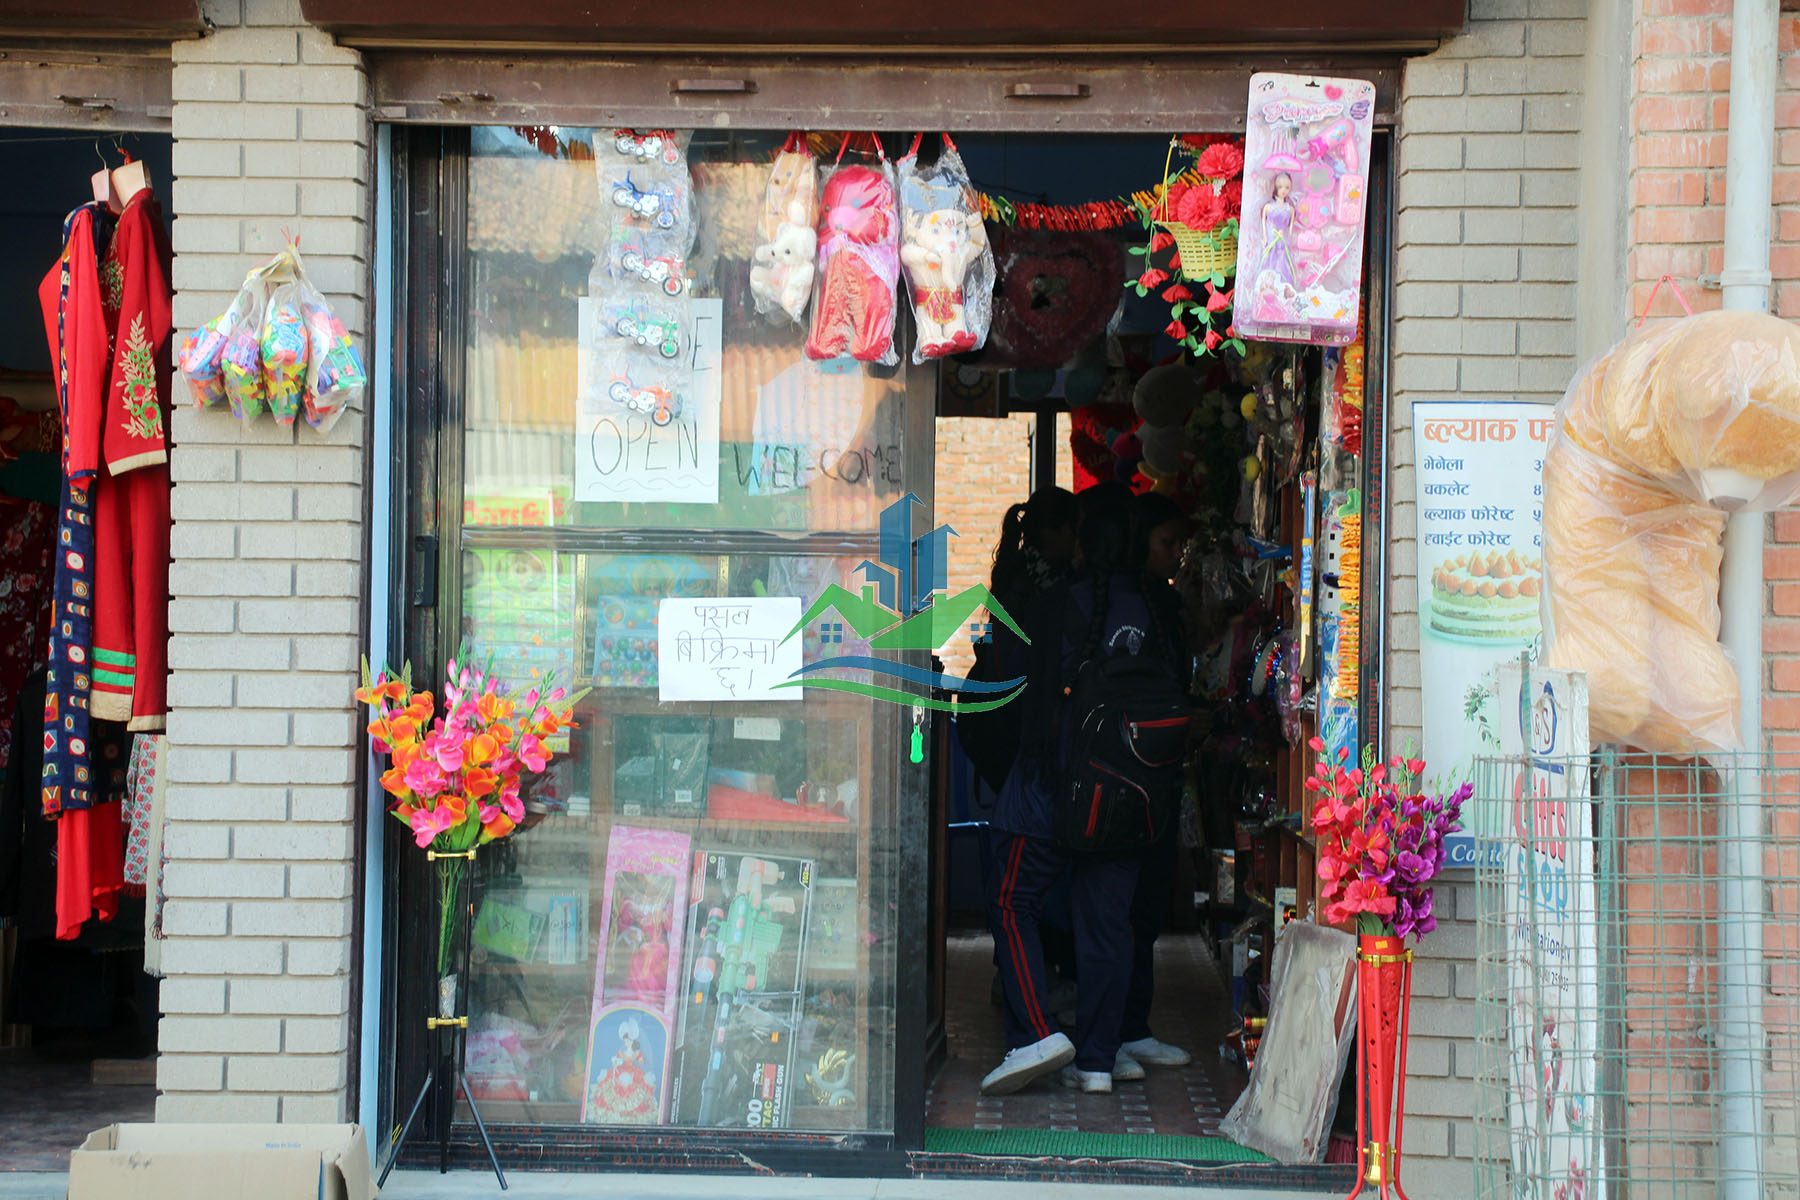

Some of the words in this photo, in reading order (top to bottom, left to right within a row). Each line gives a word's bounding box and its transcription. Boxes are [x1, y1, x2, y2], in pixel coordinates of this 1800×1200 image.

[1370, 391, 1383, 474] Aluminium
[1423, 418, 1519, 443] ब्ल्याक
[591, 417, 699, 476] OPEN
[1369, 478, 1381, 522] RAAJ
[1424, 480, 1471, 496] चकलेट
[1423, 508, 1467, 521] ब्ल्याक
[693, 605, 753, 629] पसल
[1518, 851, 1569, 927] Sop
[747, 1098, 763, 1128] 00
